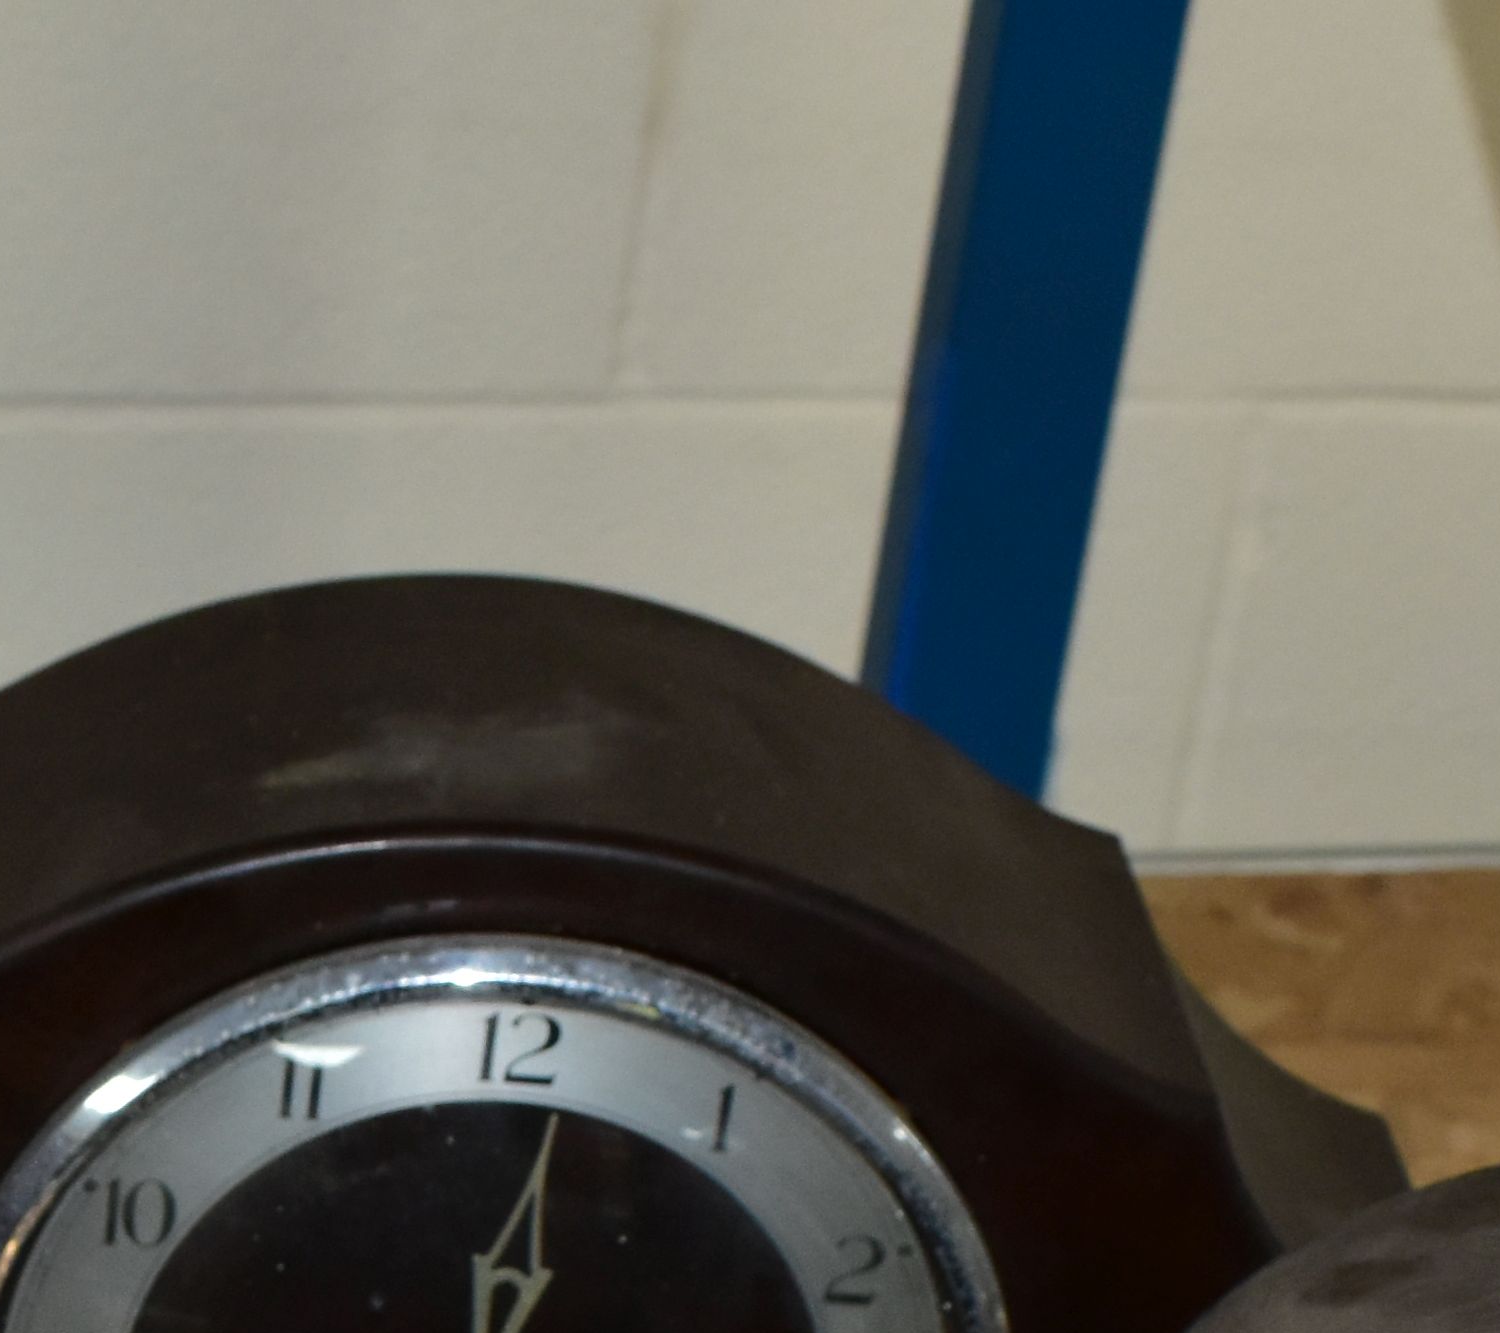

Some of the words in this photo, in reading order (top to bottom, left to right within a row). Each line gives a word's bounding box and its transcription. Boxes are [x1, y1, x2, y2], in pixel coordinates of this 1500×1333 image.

[474, 1012, 562, 1085] 12
[277, 1056, 324, 1120] 11
[710, 1084, 736, 1154] 1
[101, 1180, 178, 1248] 10
[822, 1235, 890, 1307] 2
